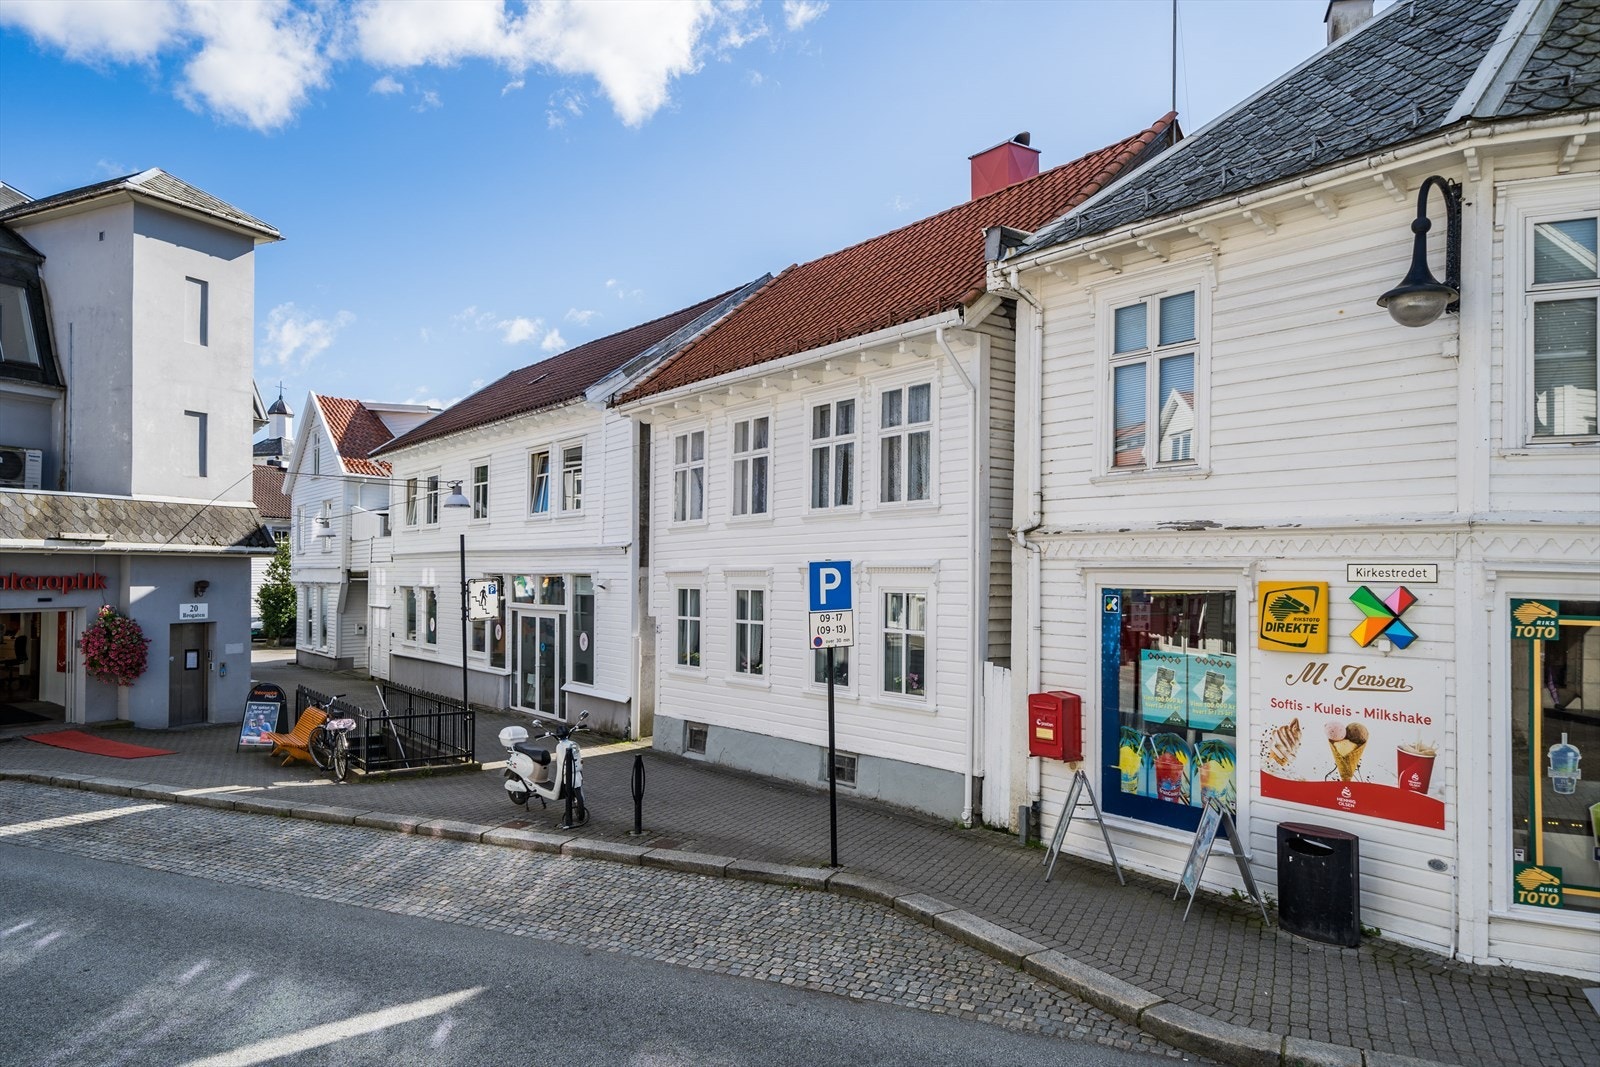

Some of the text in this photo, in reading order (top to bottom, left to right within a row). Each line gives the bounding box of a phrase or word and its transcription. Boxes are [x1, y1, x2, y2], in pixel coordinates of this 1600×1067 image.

[1356, 568, 1427, 578] Kirkestredet
[820, 567, 841, 605] P
[190, 604, 199, 612] 20
[1265, 622, 1319, 634] DIREKTE
[1515, 625, 1556, 639] TOTO
[1285, 662, 1413, 692] M. Jensen
[1270, 697, 1303, 711] Softis
[1314, 702, 1352, 717] Kuleis
[1364, 708, 1432, 725] Milkshake
[1336, 797, 1356, 805] HENNIG
[1518, 890, 1560, 906] TOTO
